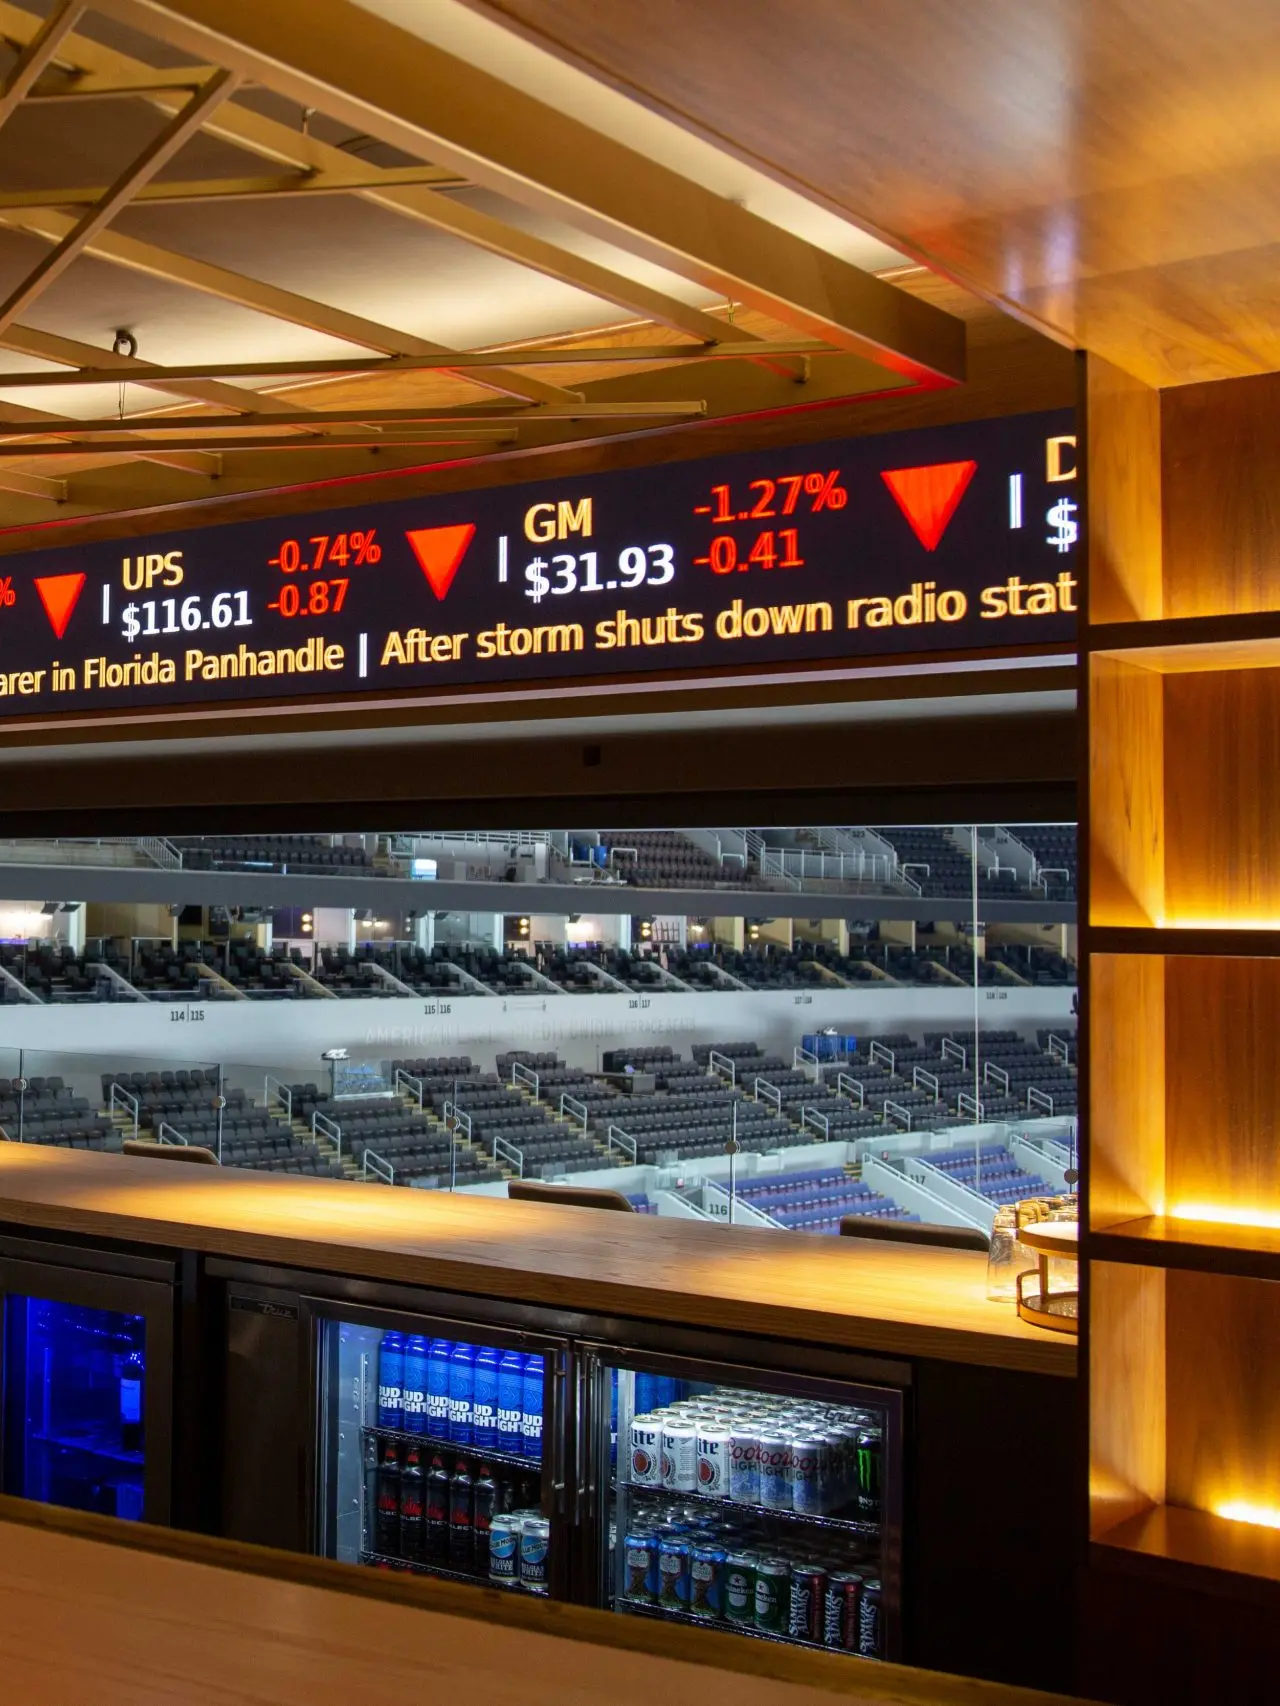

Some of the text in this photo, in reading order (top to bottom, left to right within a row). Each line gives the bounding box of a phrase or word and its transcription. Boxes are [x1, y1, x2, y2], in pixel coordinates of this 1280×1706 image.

[524, 470, 848, 543] GM -1.27%
[123, 529, 381, 591] UPS -0.74%
[525, 528, 804, 603] $31.93 -0.41
[122, 578, 349, 642] $116.61 -0.87
[380, 572, 1077, 665] After storm shuts down radio stat
[52, 661, 75, 691] in
[84, 652, 175, 689] Florida
[185, 637, 344, 680] Panhandle
[170, 1010, 205, 1021] 114 115
[424, 1004, 451, 1015] 115 116
[709, 1203, 728, 1215] 116
